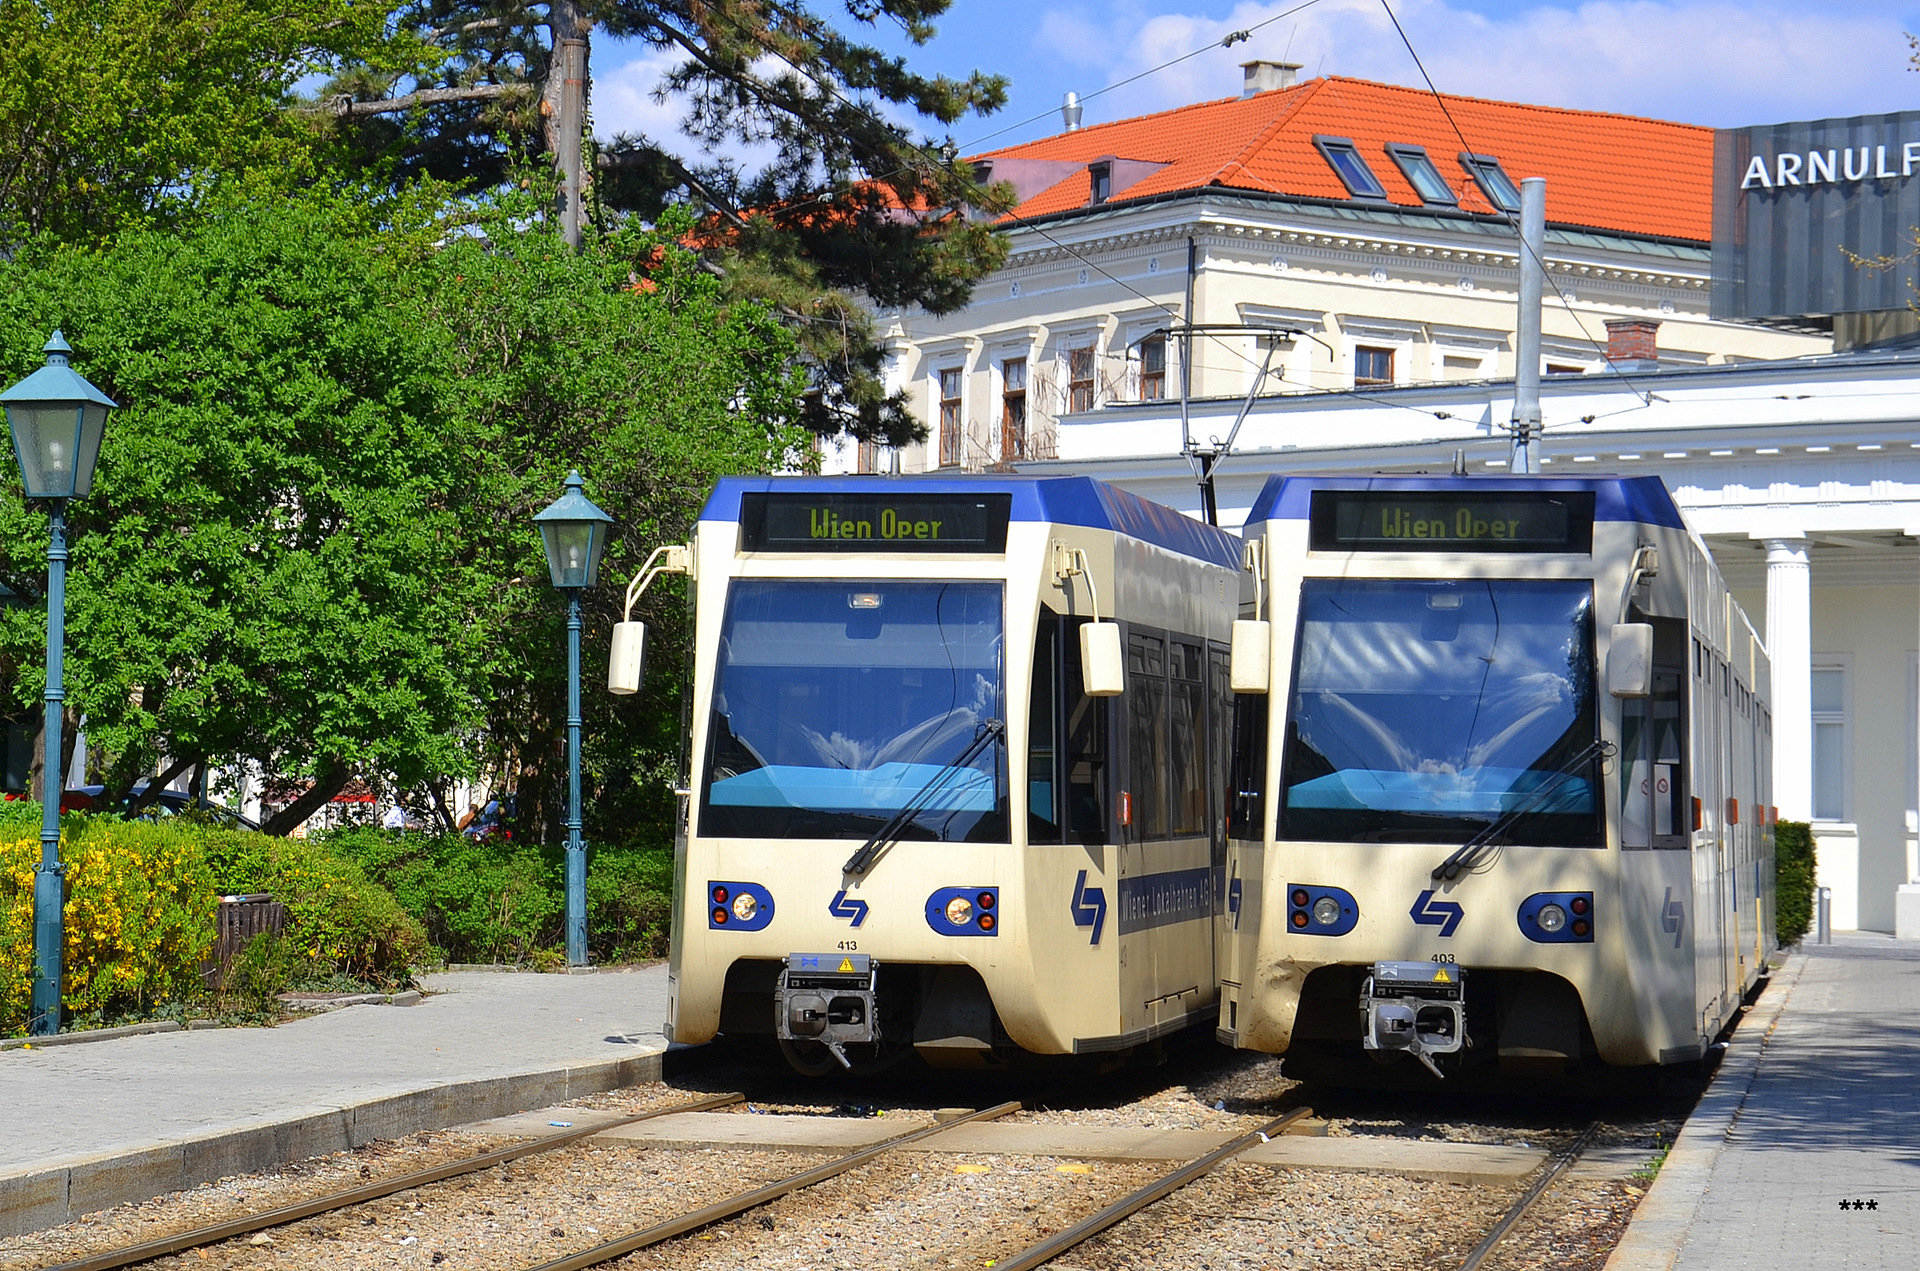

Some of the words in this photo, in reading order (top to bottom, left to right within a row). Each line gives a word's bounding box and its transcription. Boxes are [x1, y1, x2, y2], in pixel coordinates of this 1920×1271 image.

[810, 508, 871, 539] Wien
[881, 508, 942, 539] Oper
[1381, 508, 1446, 538] Wien
[1455, 508, 1520, 538] Oper
[1122, 890, 1149, 922] Wiener
[837, 940, 857, 951] 413
[1431, 953, 1455, 964] 403
